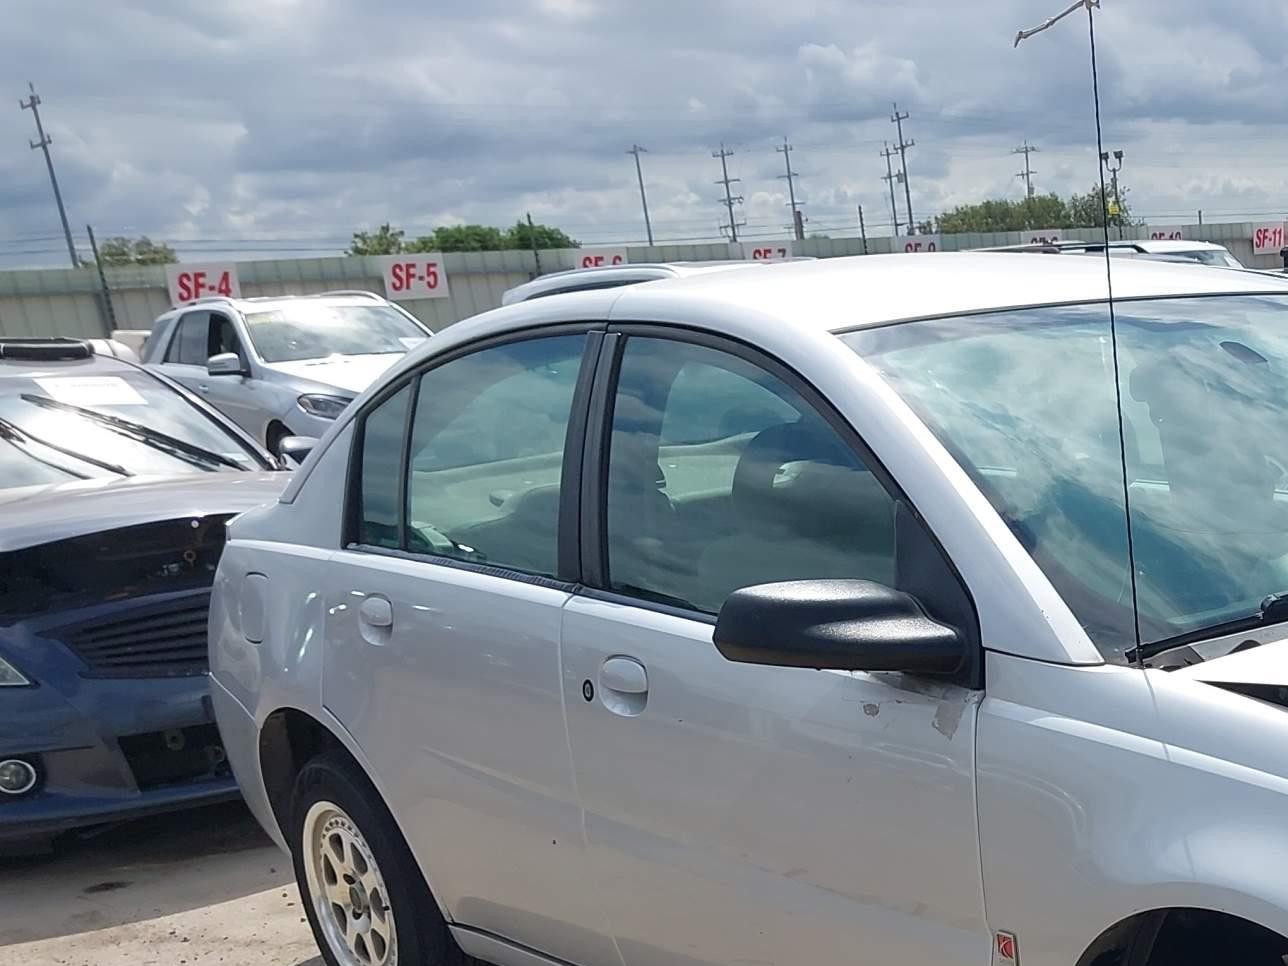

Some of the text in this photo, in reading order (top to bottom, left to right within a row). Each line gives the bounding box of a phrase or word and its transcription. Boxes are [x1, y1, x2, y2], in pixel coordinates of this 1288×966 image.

[1255, 228, 1282, 249] SF-11
[177, 271, 232, 302] SF-4
[391, 262, 439, 292] SF-5
